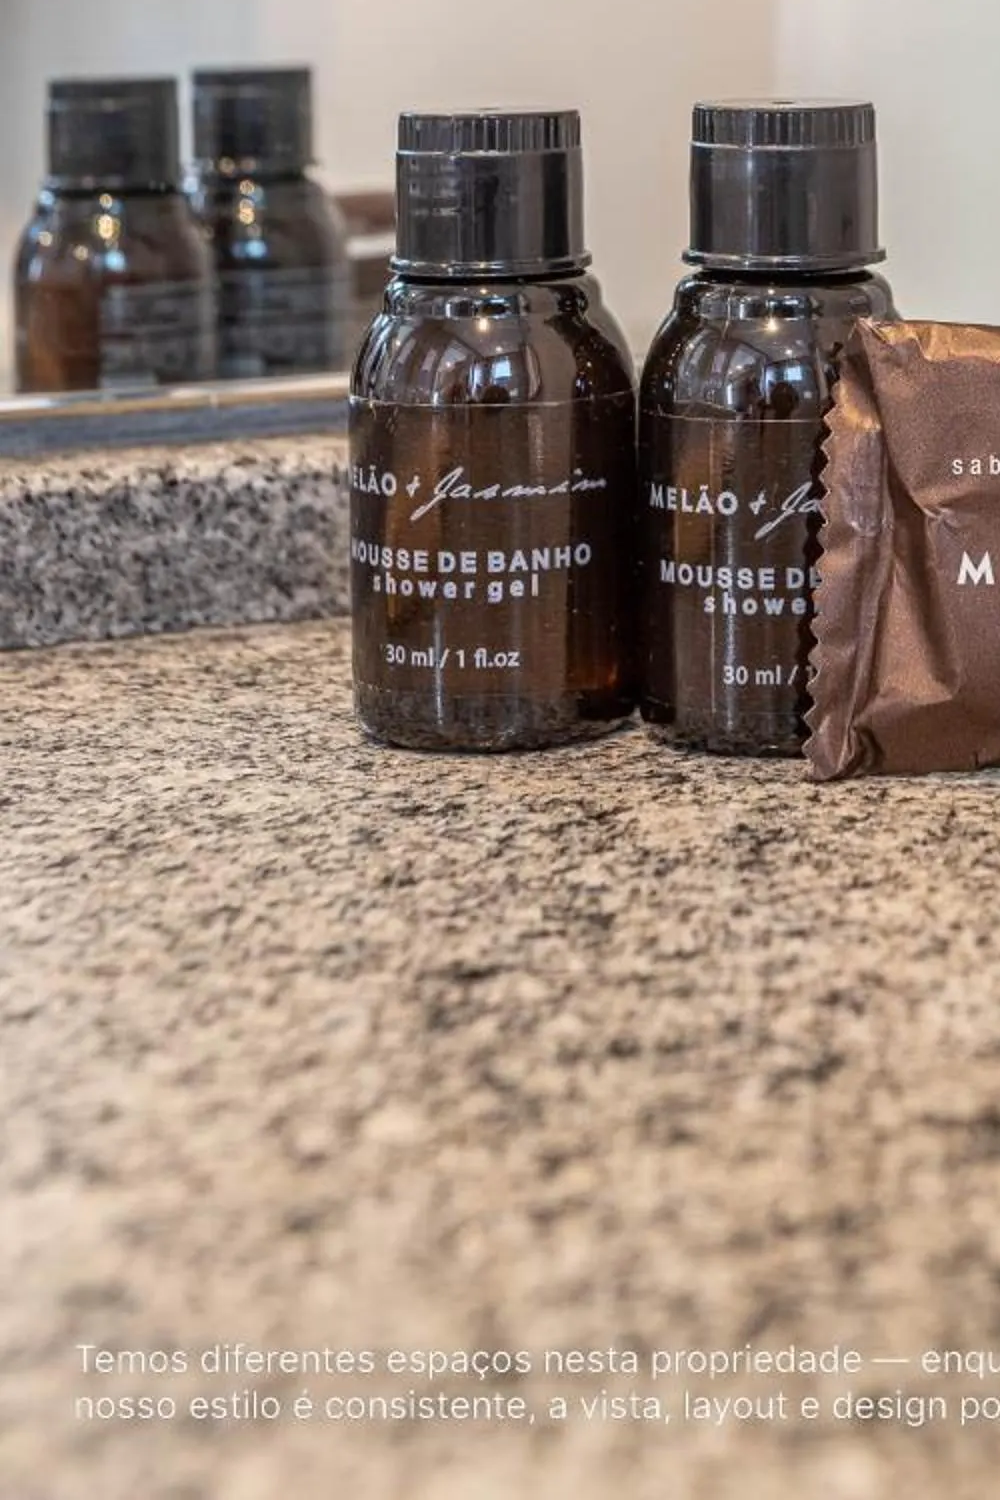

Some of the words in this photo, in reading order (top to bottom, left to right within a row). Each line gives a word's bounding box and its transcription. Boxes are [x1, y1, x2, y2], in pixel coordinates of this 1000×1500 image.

[649, 483, 739, 516] MELÃO
[437, 551, 477, 574] DE
[487, 543, 592, 573] BANHO
[660, 558, 776, 591] MOUSSE
[372, 570, 476, 599] shower
[486, 572, 540, 603] gel
[384, 643, 405, 665] 30
[411, 647, 434, 668] ml
[438, 648, 450, 670] /
[455, 649, 466, 669] 1
[723, 664, 749, 686] 30
[754, 663, 781, 686] ml
[786, 663, 799, 686] /
